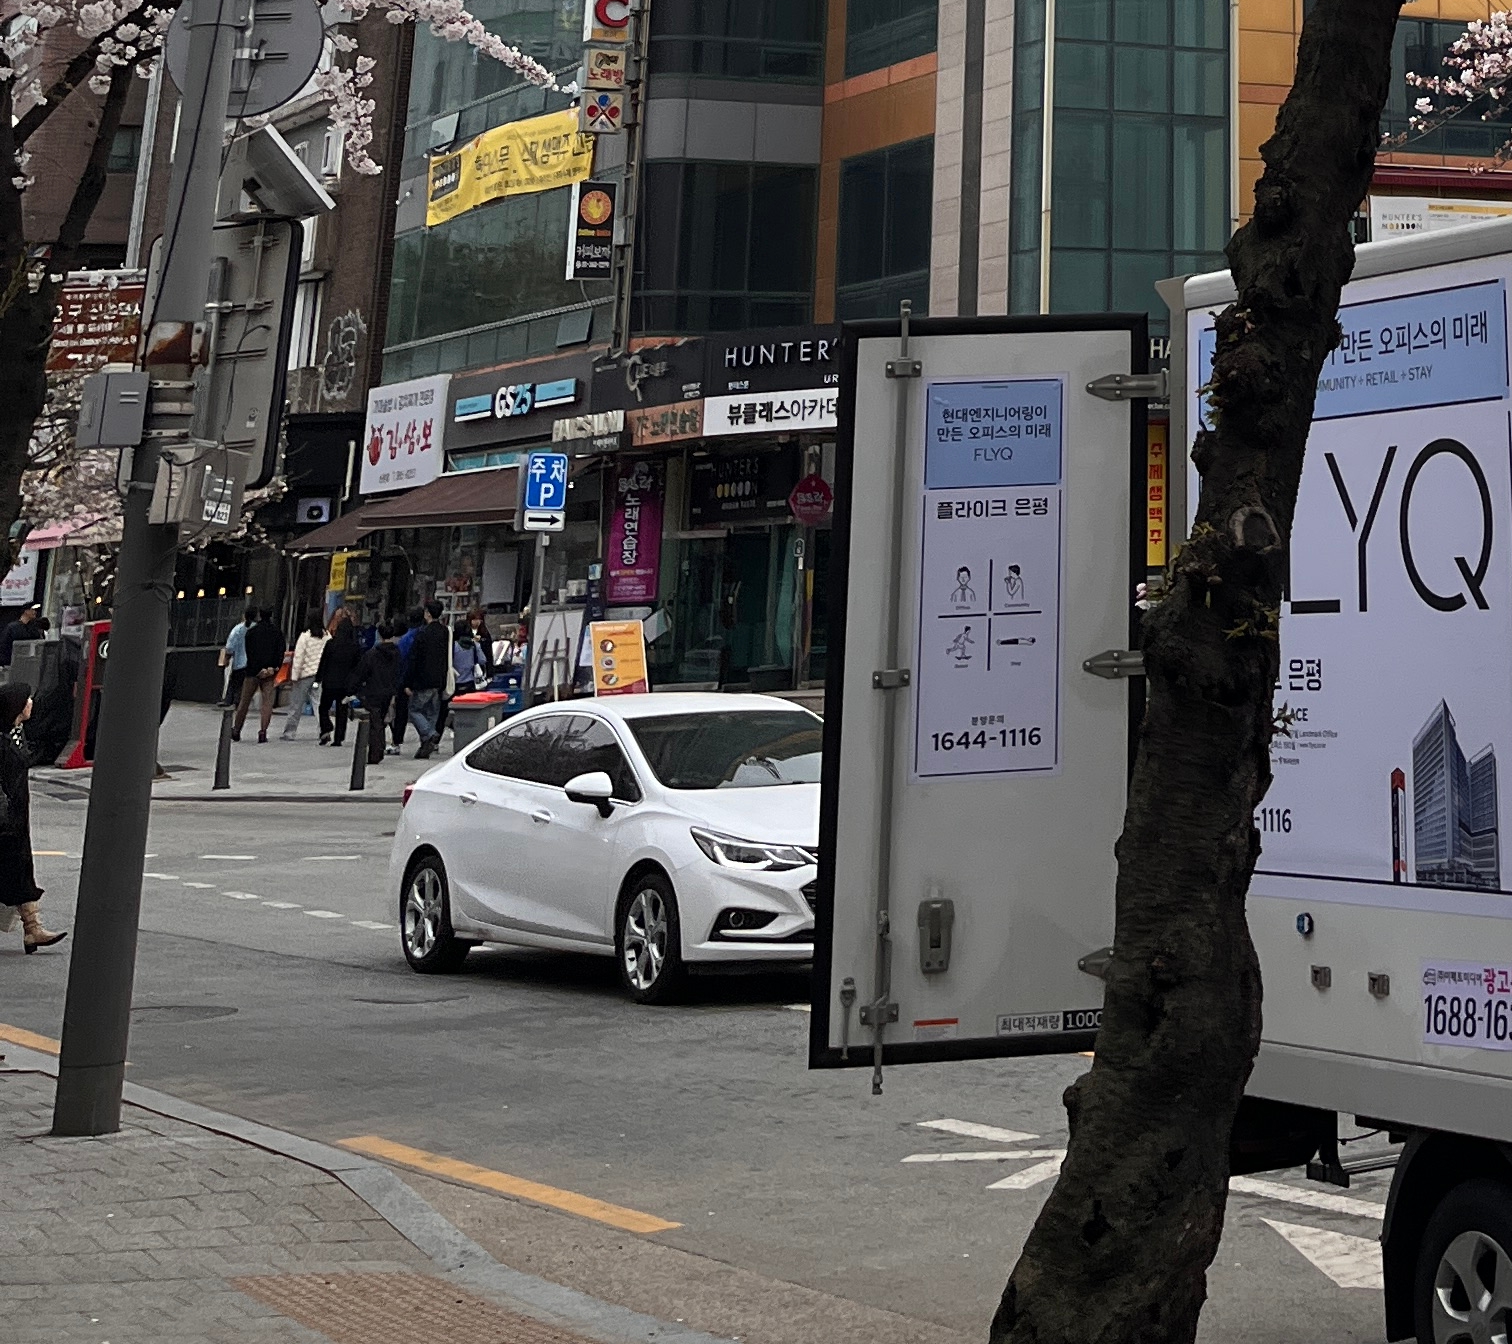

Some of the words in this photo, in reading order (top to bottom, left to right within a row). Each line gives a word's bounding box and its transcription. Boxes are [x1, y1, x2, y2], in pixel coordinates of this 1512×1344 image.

[587, 67, 624, 86] 노래방
[1341, 328, 1373, 364] 만든
[1378, 316, 1446, 356] 오피스의
[1453, 310, 1488, 347] 미래
[1365, 370, 1399, 386] RETAIL
[1408, 365, 1433, 381] STAY
[495, 383, 535, 418] GS25
[942, 405, 1047, 424] 현대엔지니어링이
[937, 427, 964, 443] 만든
[968, 425, 1021, 440] 오피스의
[1026, 423, 1052, 439] 미래
[973, 447, 1014, 462] FLYQ
[531, 457, 565, 483] 주차
[540, 483, 555, 507] P
[937, 499, 1008, 520] 플라이크
[1014, 497, 1048, 517] 은평
[621, 493, 642, 565] 노래연습장
[1289, 658, 1322, 691] 은평
[931, 727, 1042, 751] 1644-1116
[1000, 1015, 1061, 1032] 최대적재량
